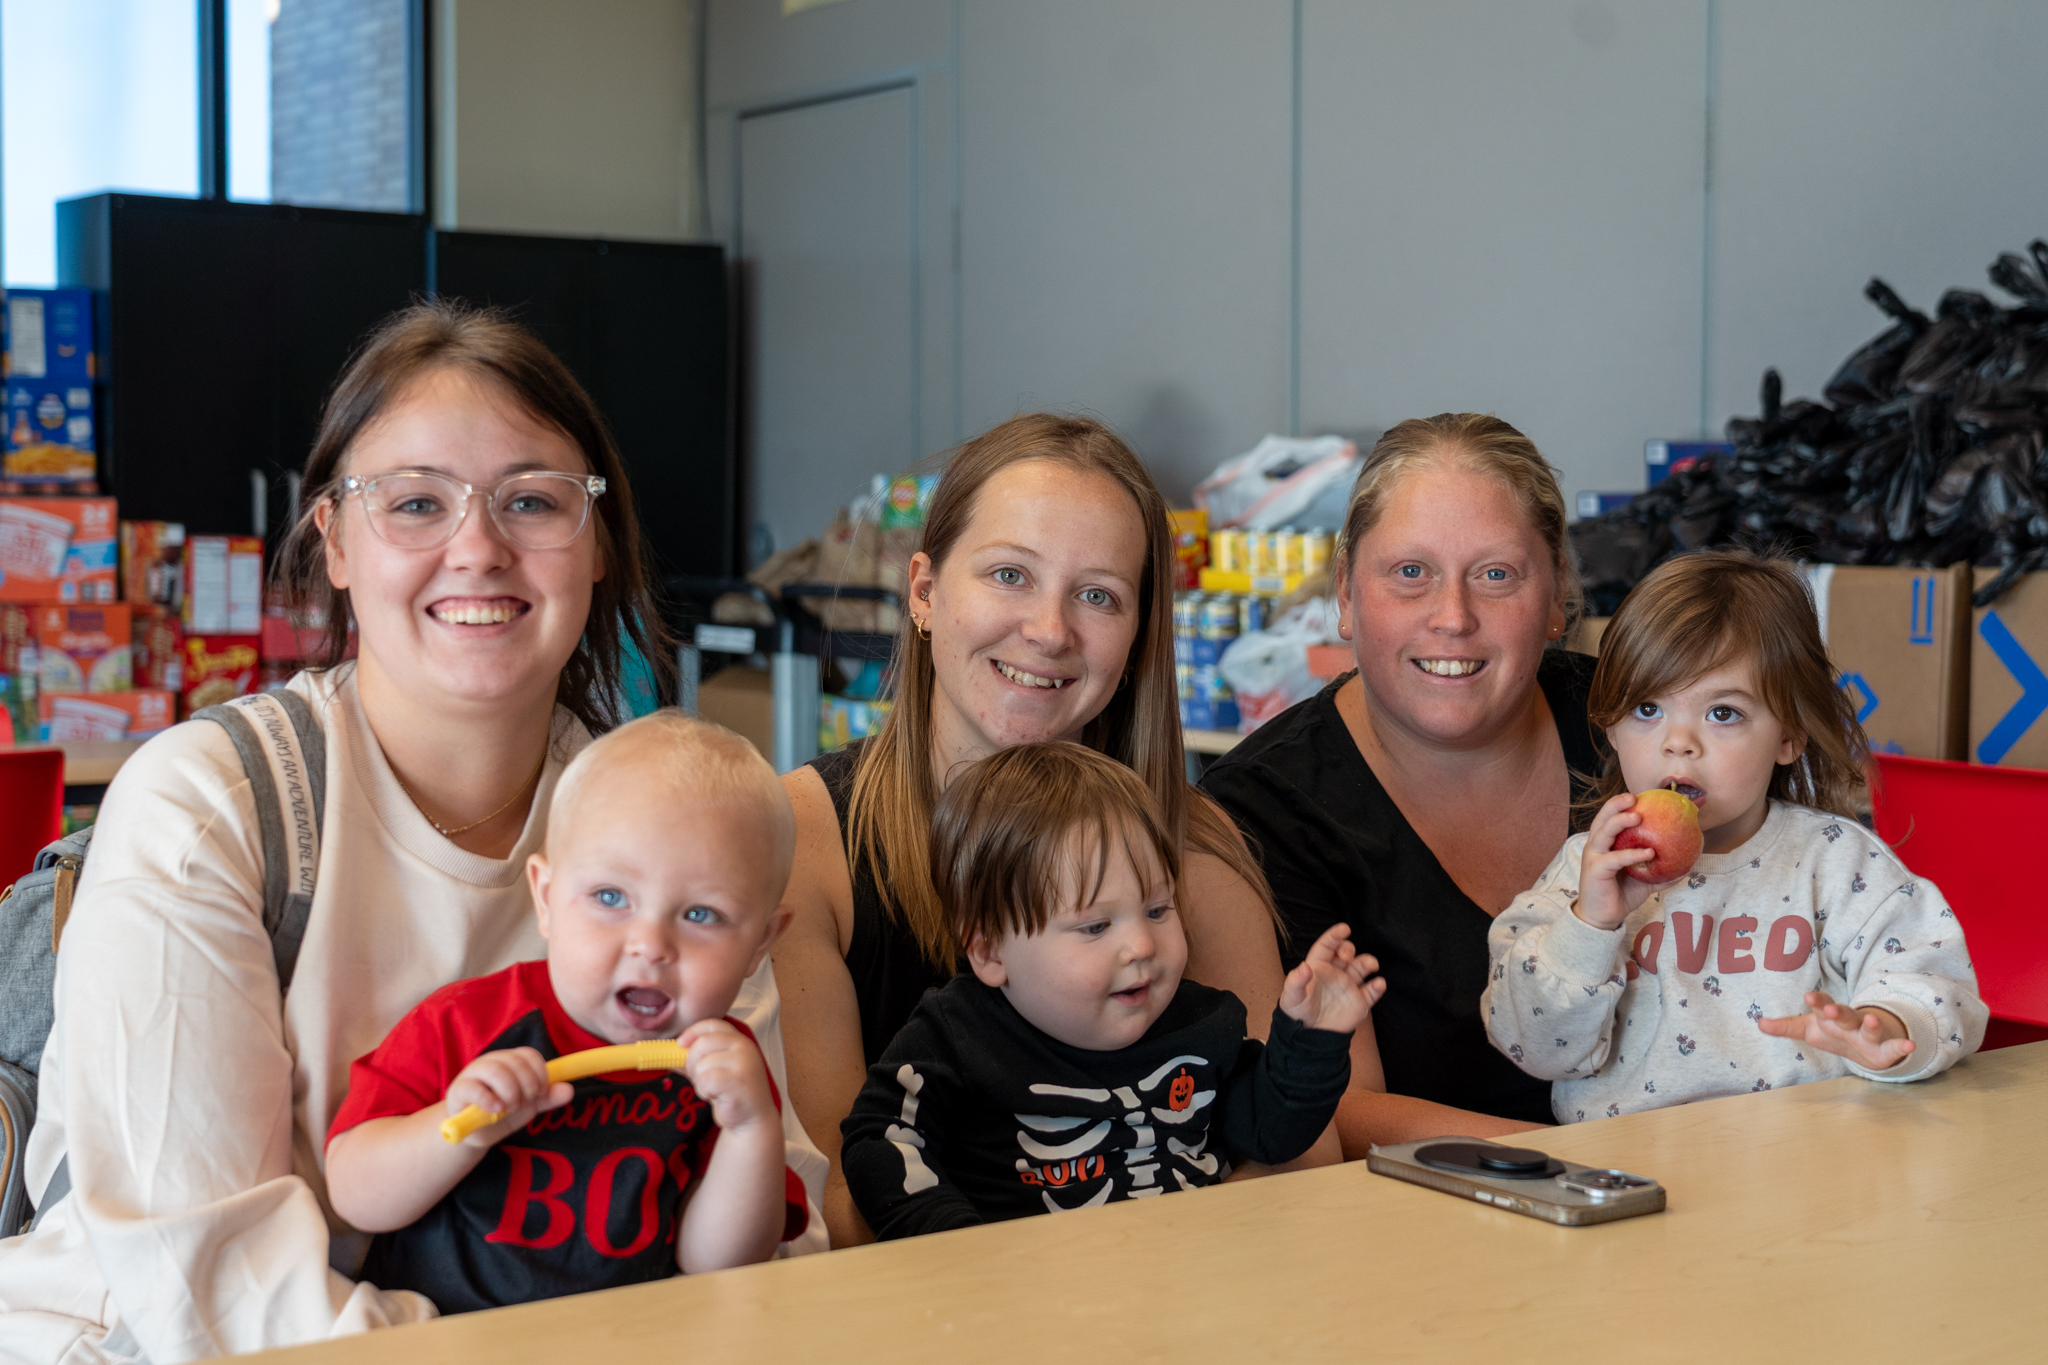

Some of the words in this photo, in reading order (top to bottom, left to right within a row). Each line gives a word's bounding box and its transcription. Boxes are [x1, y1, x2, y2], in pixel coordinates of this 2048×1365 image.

[262, 718, 295, 758] ALWAYS
[280, 758, 300, 779] AN
[287, 779, 314, 863] ADVENTURE
[1626, 911, 1814, 981] OVED
